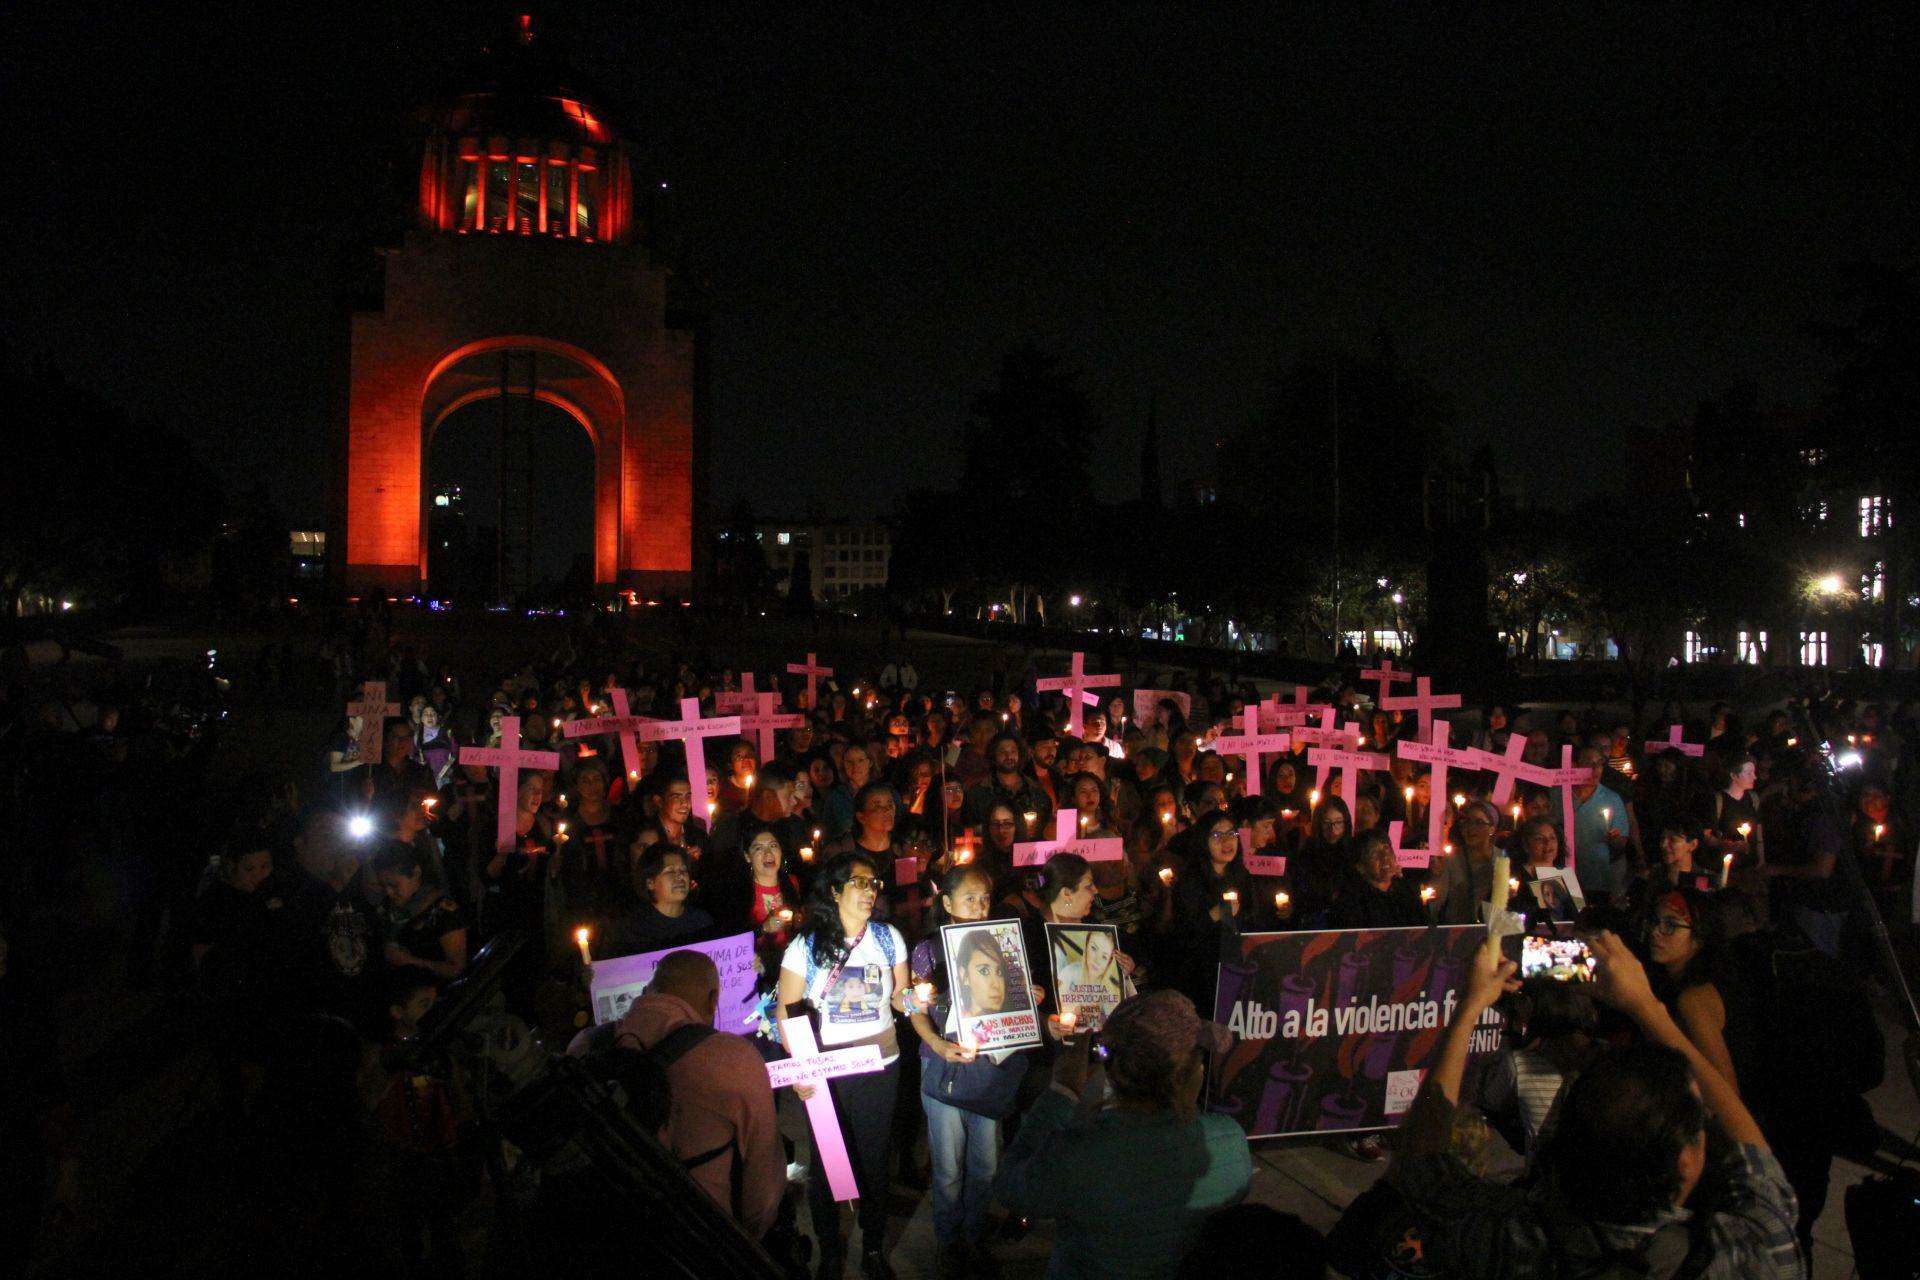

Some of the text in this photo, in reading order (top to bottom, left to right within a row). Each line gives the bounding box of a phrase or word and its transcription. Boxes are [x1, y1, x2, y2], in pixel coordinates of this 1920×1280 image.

[1062, 994, 1120, 1004] IRREVOCABLE
[1001, 1014, 1034, 1028] MACHOS
[1228, 1000, 1277, 1040] Alto
[1282, 1009, 1300, 1038] a
[1305, 998, 1328, 1038] la
[1335, 991, 1437, 1035] violencia
